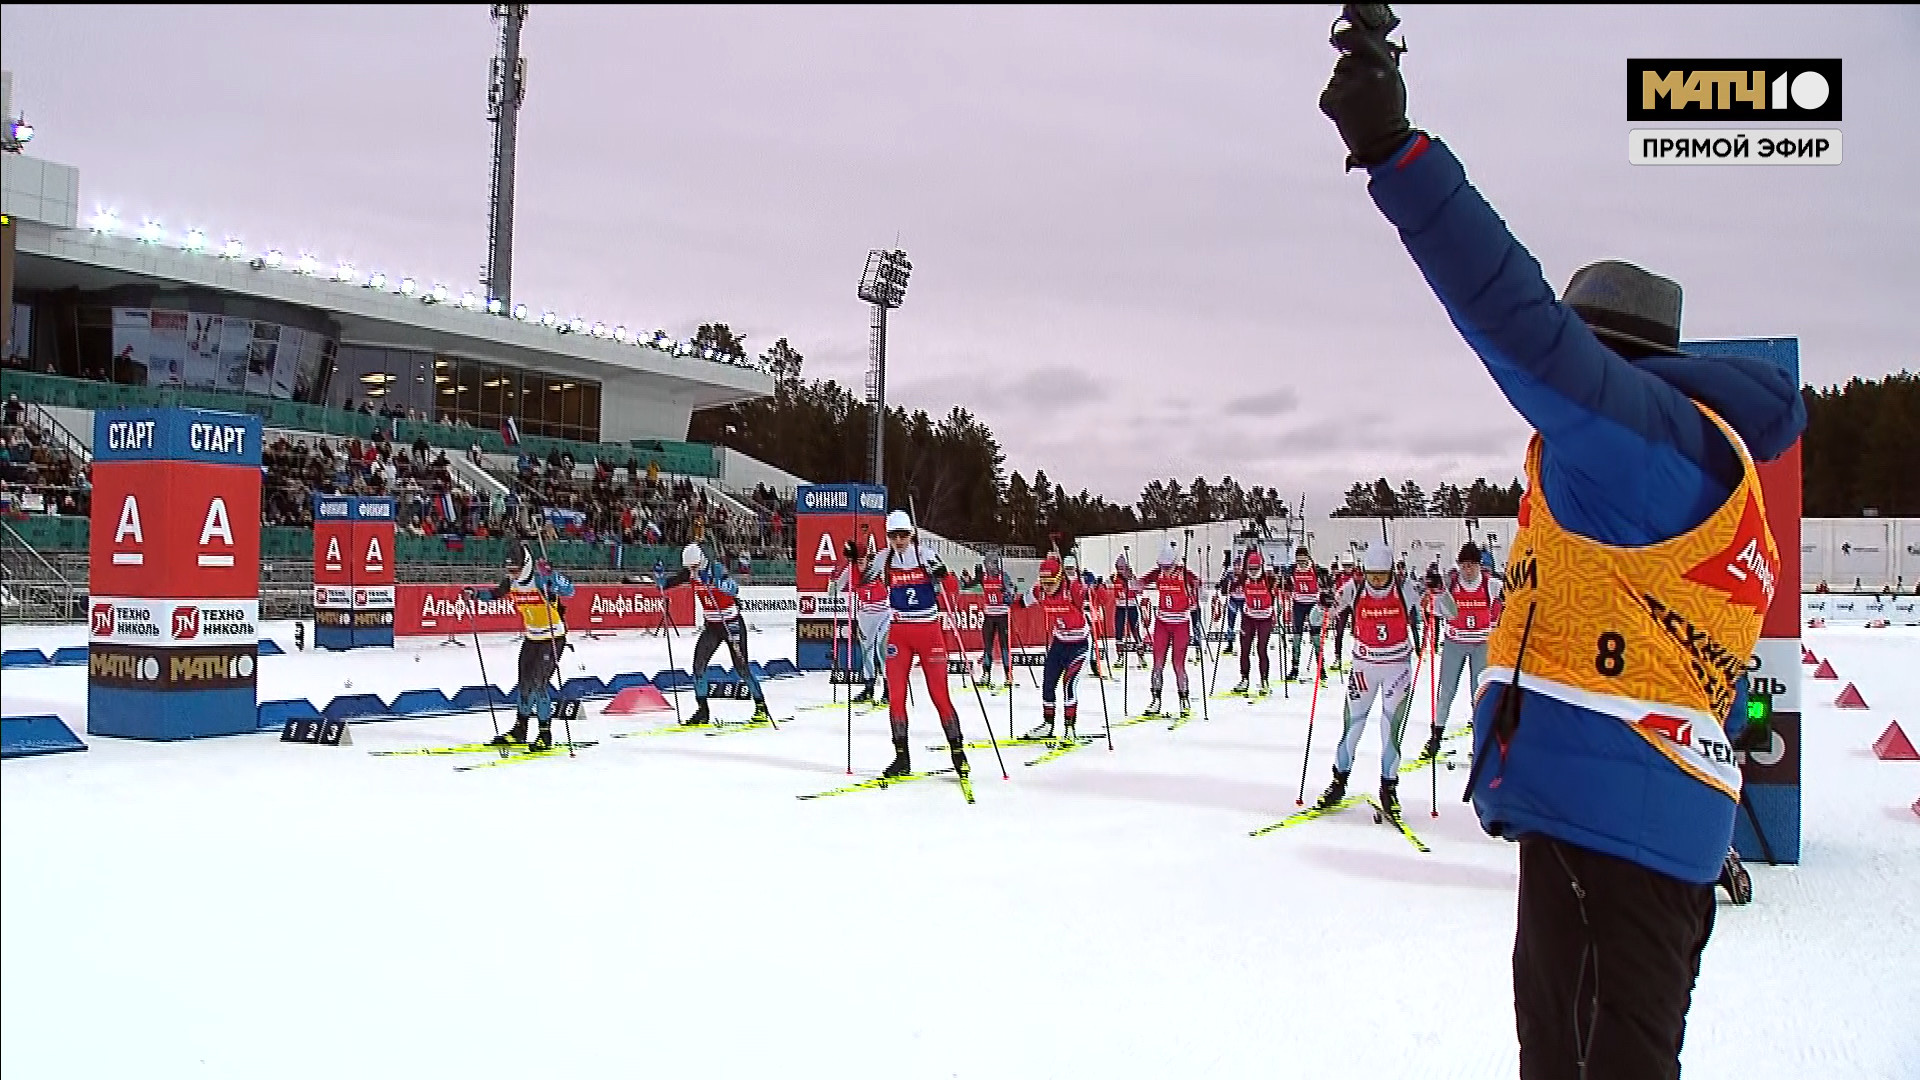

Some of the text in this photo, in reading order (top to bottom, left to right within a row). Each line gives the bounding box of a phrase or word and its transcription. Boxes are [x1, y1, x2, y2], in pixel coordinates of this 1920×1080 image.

[109, 421, 155, 449] СТАРТ
[190, 423, 245, 454] СТАРТ
[805, 491, 847, 507] ФИНИШ
[905, 587, 919, 605] 2
[116, 608, 150, 620] ТЕХНО
[203, 609, 244, 621] ТЕХНО
[117, 622, 160, 636] НИКОЛЬ
[203, 623, 254, 635] НИКОЛЬ
[1376, 623, 1388, 641] 3
[1595, 632, 1625, 676] 8
[709, 683, 717, 696] 7
[290, 721, 338, 741] 1 2 3
